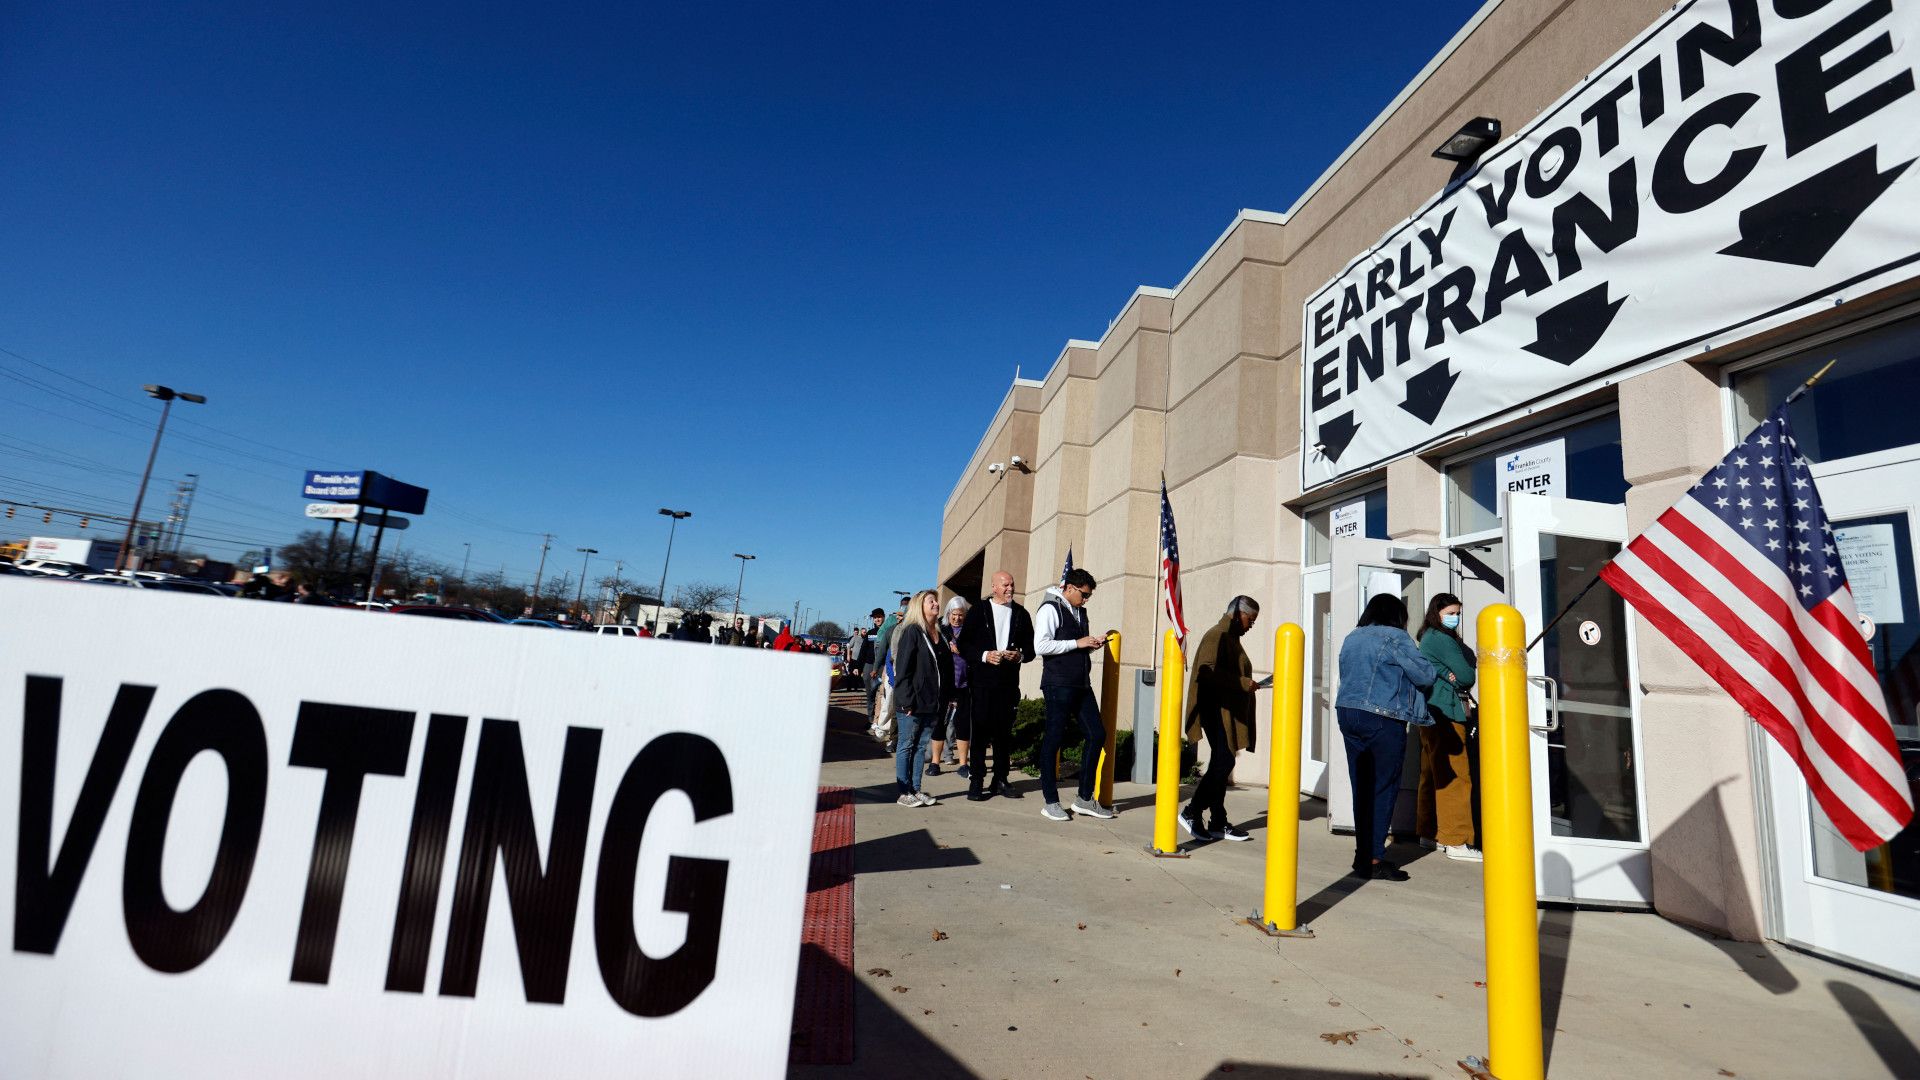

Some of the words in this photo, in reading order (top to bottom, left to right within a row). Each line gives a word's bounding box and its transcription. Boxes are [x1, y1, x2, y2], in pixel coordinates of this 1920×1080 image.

[1312, 0, 1916, 412] ENTRANCE
[1313, 209, 1456, 349] EARLY
[1335, 522, 1357, 535] ENTER
[1508, 474, 1551, 492] ENTER
[13, 674, 734, 1018] VOTING
